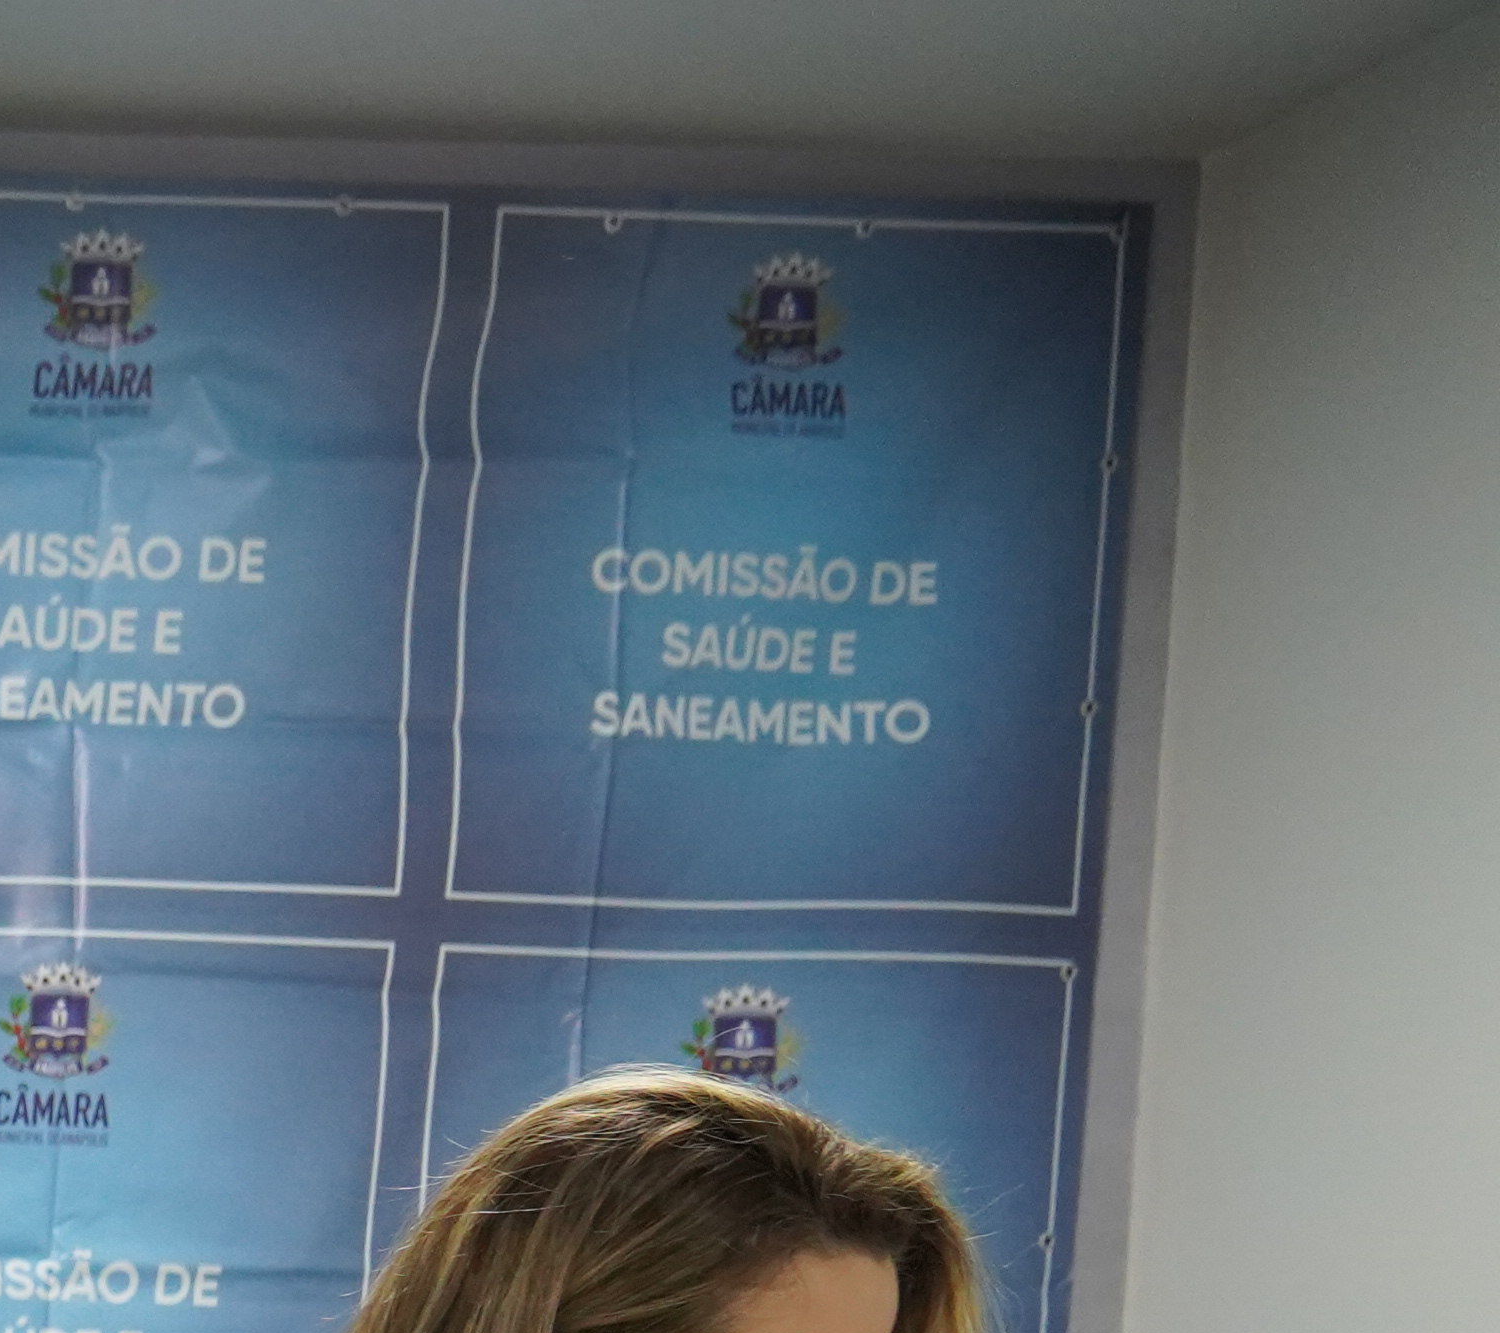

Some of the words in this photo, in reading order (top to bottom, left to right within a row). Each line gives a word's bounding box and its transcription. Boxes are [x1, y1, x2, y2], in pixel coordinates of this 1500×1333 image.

[33, 353, 153, 400] CÂMARA
[199, 537, 268, 585] DE
[590, 545, 859, 604] COMISSÃO
[869, 560, 940, 606] DE
[153, 609, 185, 656] E
[661, 613, 816, 675] SAÚDE
[829, 629, 858, 676] E
[589, 690, 932, 746] SANEAMENTO
[154, 1261, 223, 1309] DE
